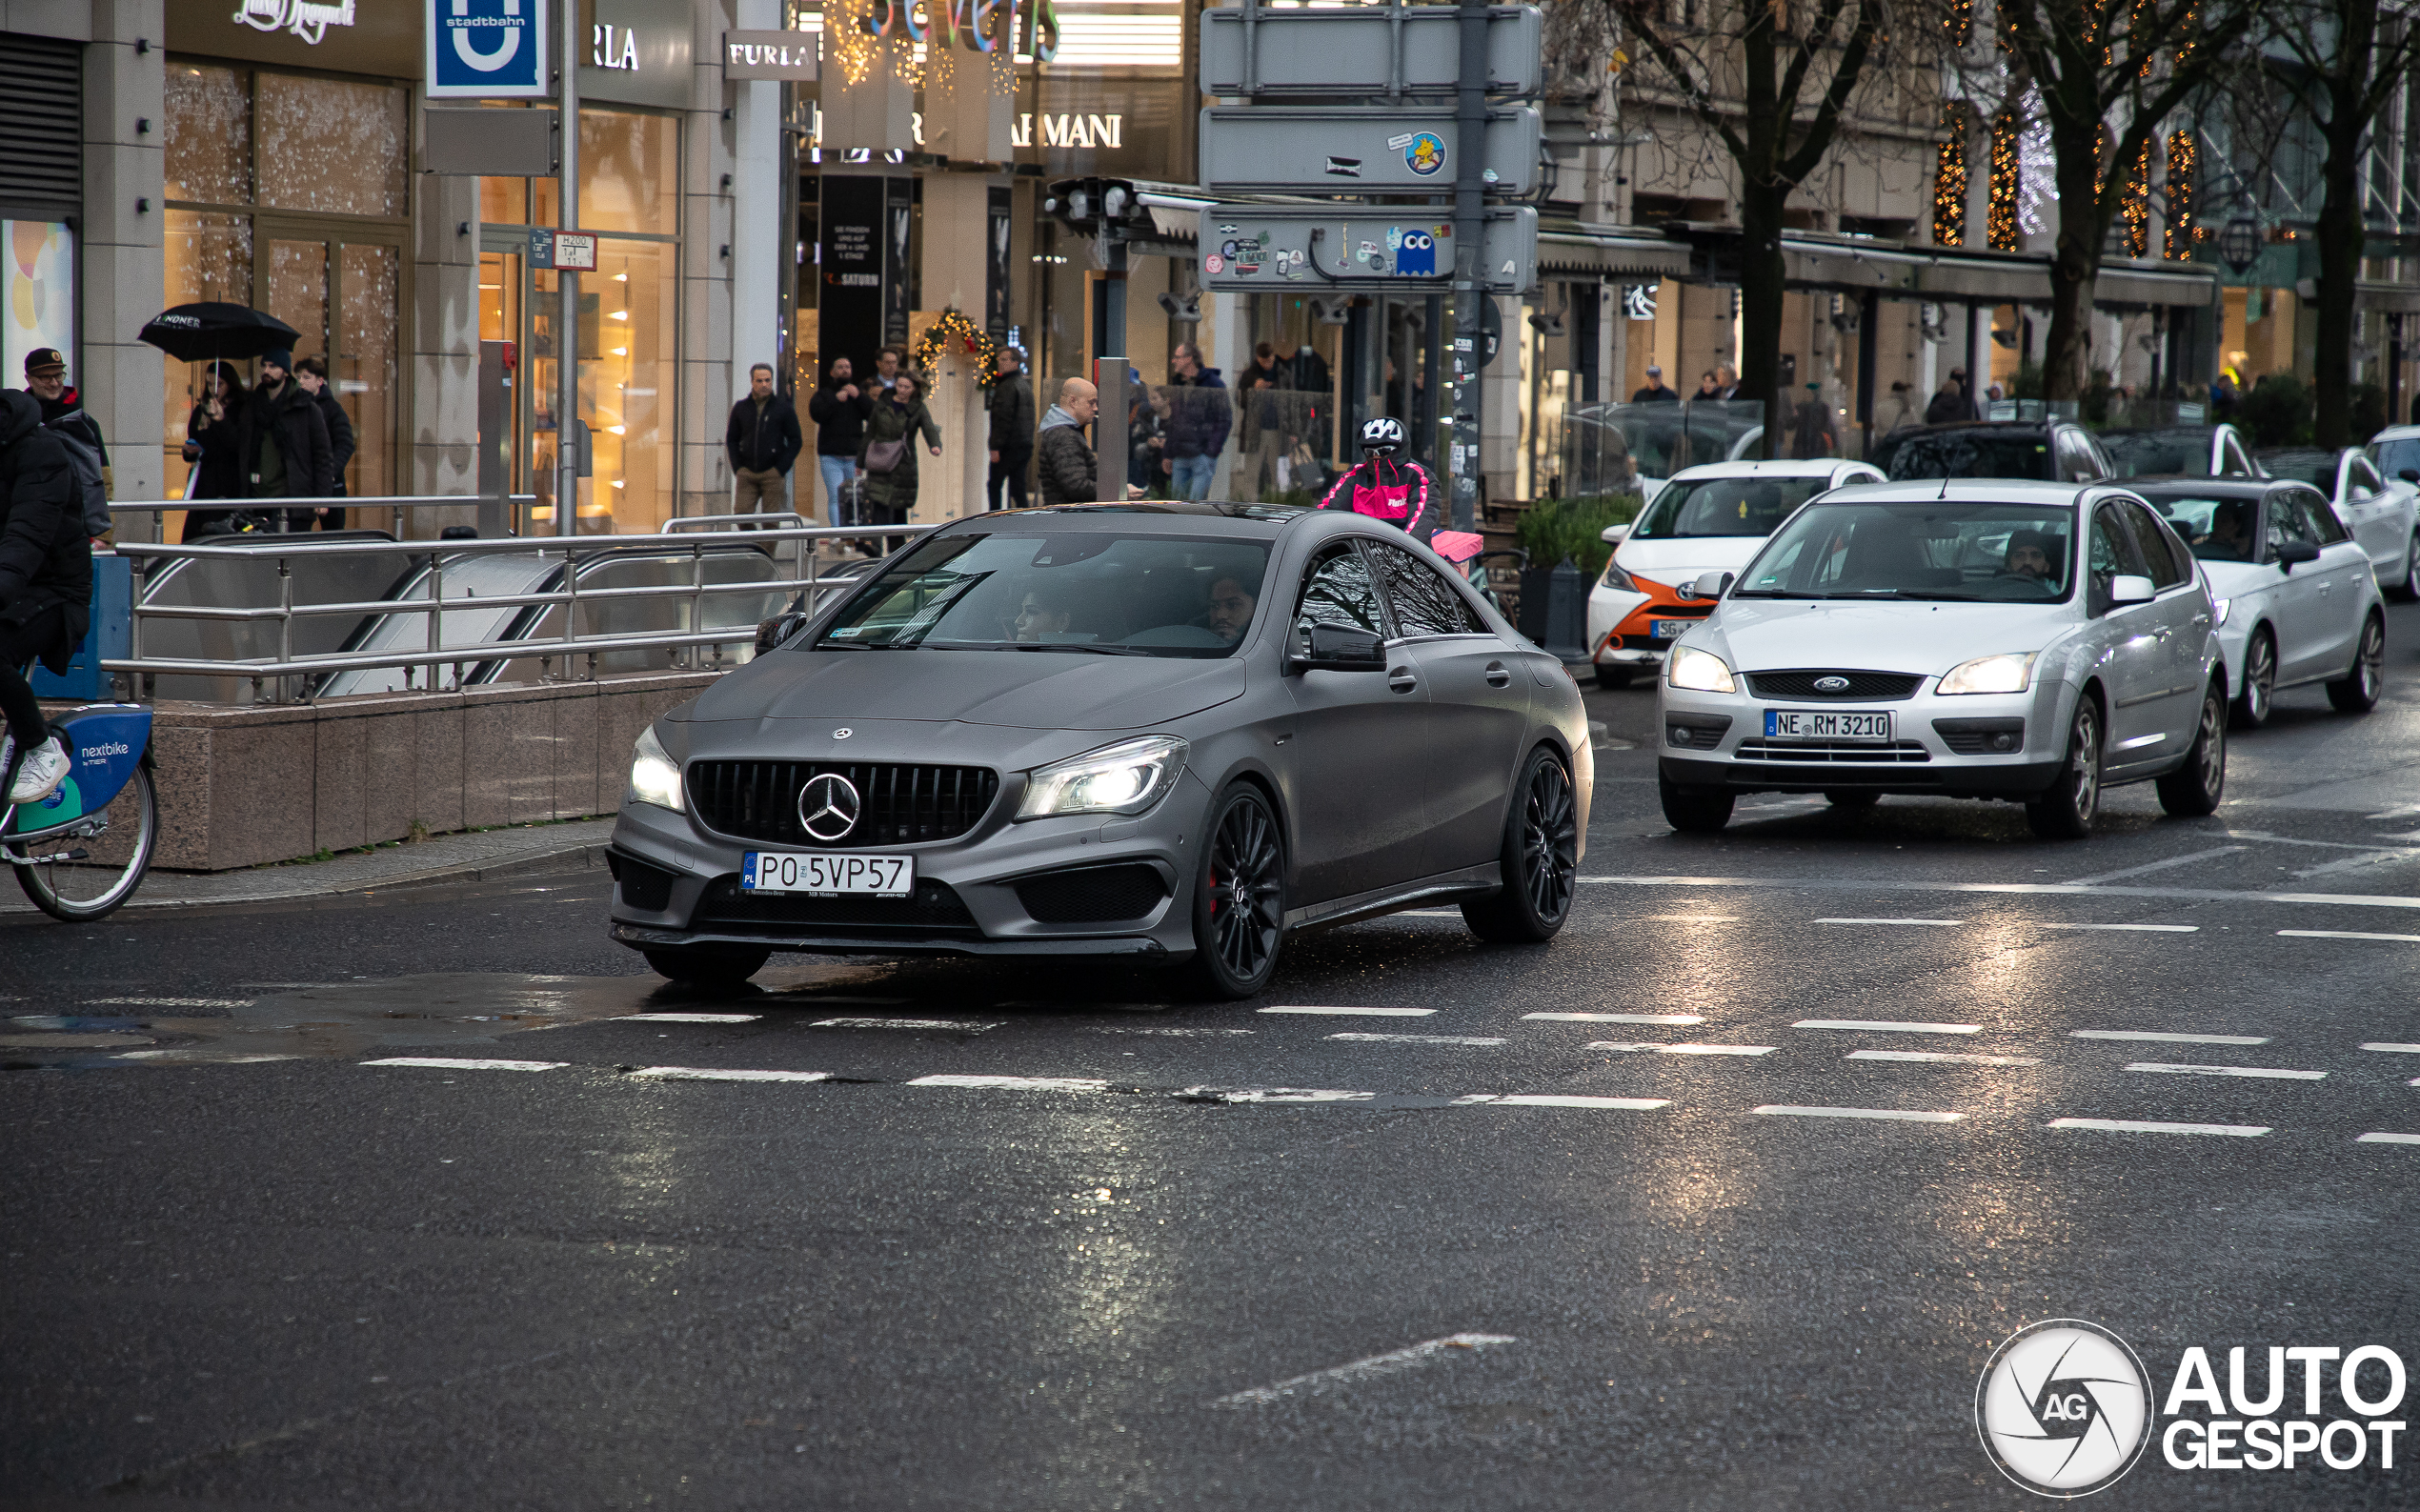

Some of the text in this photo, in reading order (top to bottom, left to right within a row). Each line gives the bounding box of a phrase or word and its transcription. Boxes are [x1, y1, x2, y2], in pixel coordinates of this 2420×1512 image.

[447, 16, 525, 27] stadtbahn
[729, 43, 810, 67] FURLA
[563, 236, 587, 246] H200
[841, 272, 879, 286] SATURN
[1661, 622, 1677, 635] SG
[1778, 715, 1886, 736] NE RM 3210
[82, 741, 129, 757] nextbike
[744, 875, 755, 883] PL
[761, 857, 904, 889] PO 5VP57
